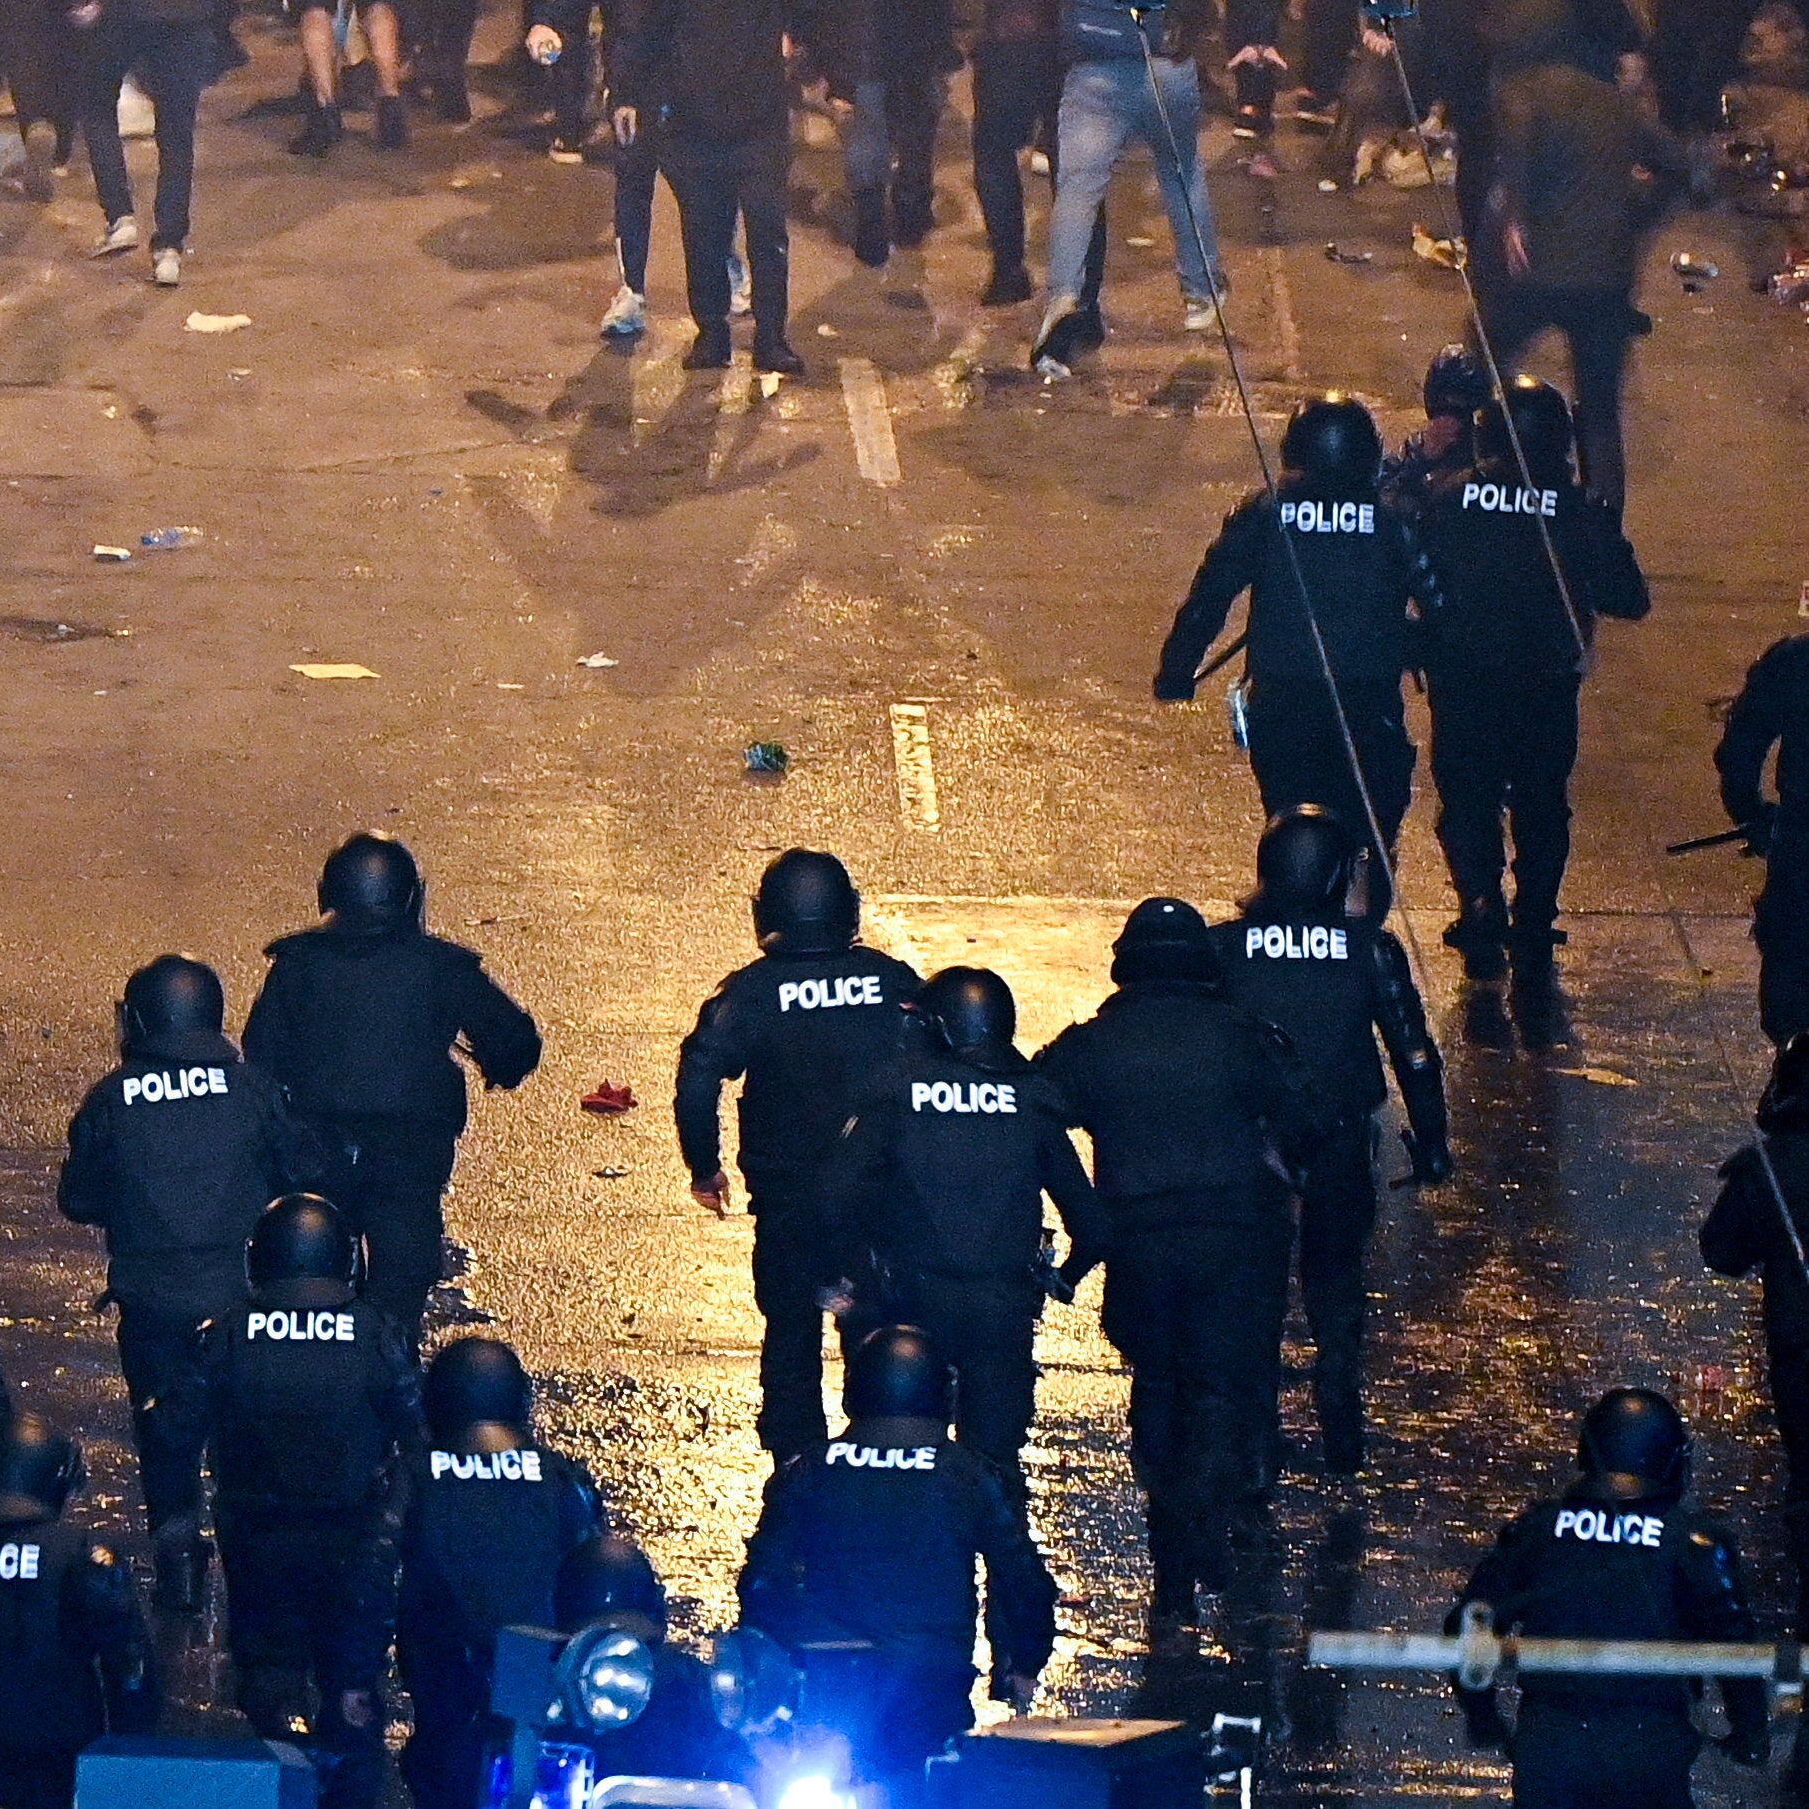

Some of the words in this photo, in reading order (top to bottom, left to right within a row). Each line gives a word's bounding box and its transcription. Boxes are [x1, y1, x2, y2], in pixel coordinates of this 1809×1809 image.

[1280, 500, 1375, 534] POLICE
[1462, 483, 1558, 517] POLICE
[1246, 924, 1349, 960] POLICE
[778, 975, 884, 1013] POLICE
[122, 1067, 229, 1106] POLICE
[911, 1081, 1018, 1114] POLICE
[247, 1310, 355, 1341] POLICE
[430, 1448, 543, 1482] POLICE
[825, 1442, 937, 1470] POLICE
[1554, 1509, 1665, 1547] POLICE
